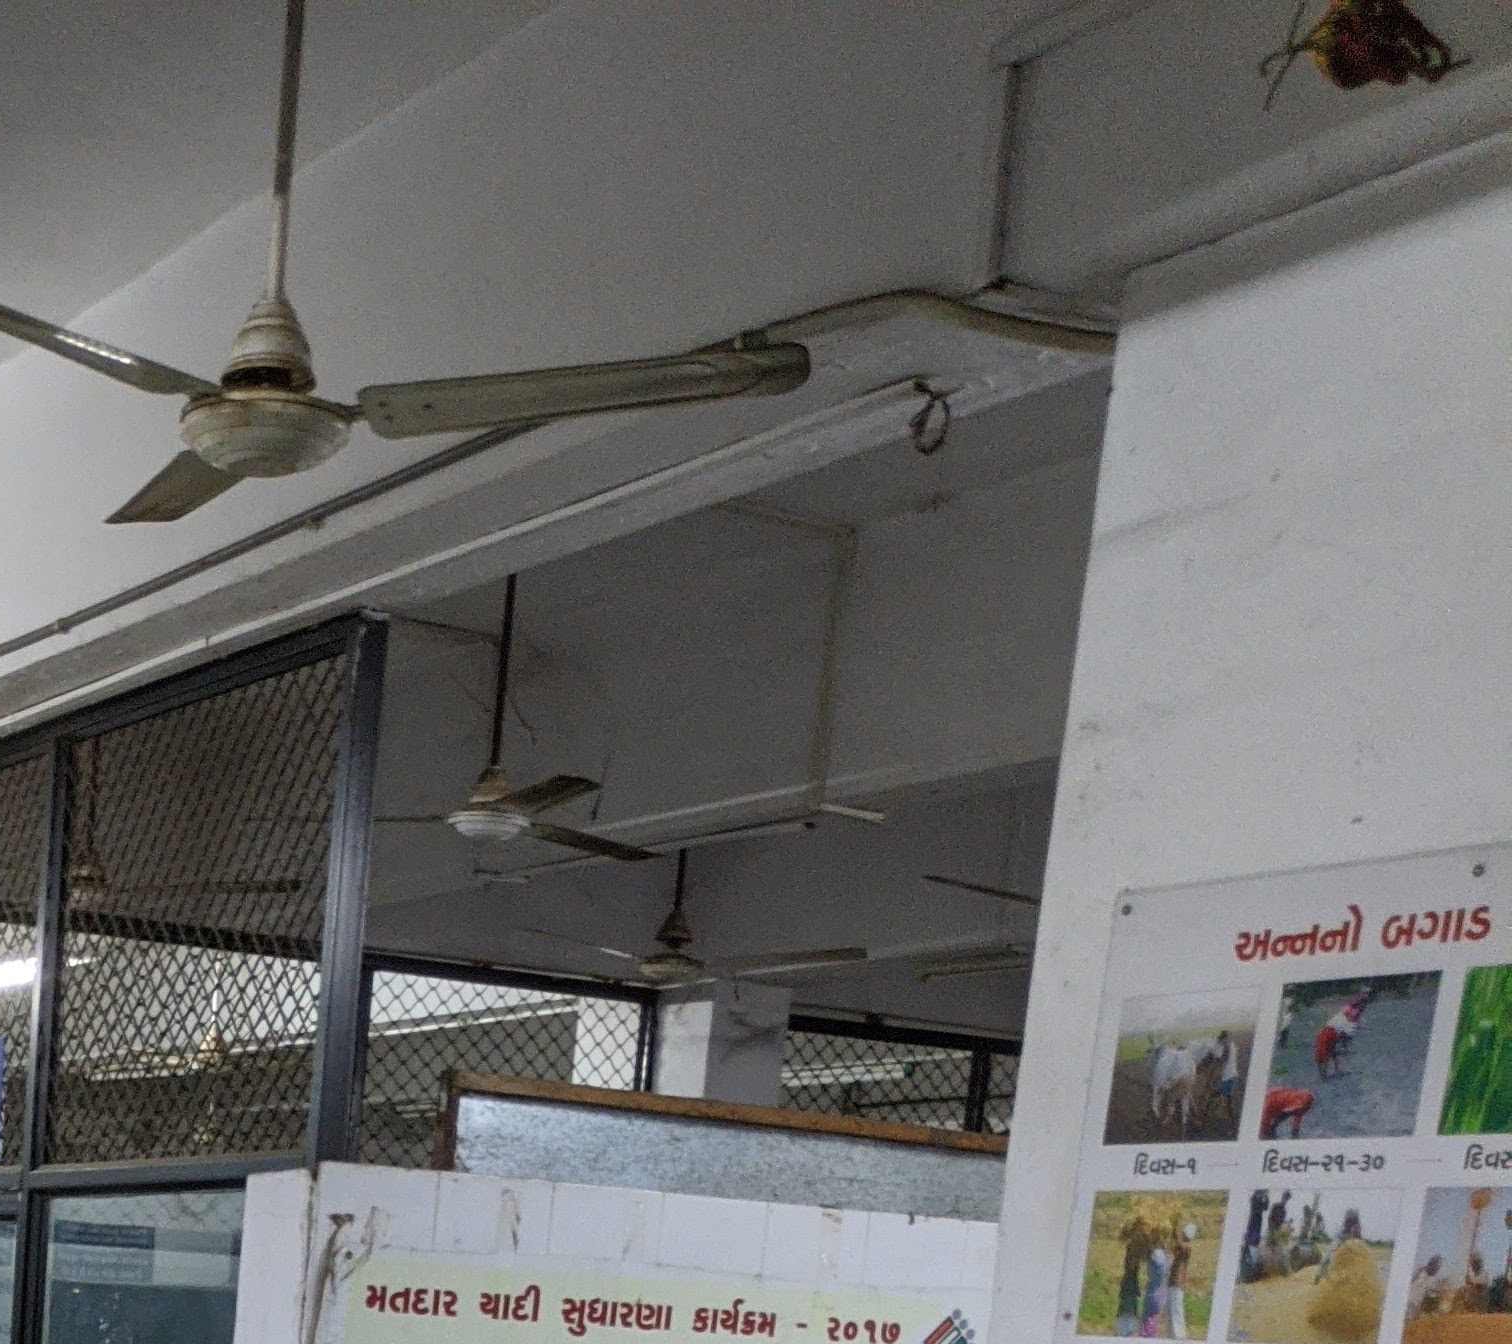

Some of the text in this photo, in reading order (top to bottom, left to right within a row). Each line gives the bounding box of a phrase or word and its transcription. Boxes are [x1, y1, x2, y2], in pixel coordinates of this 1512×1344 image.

[1234, 904, 1491, 961] અન્નનો બગાડ
[1134, 1152, 1196, 1175] દિવસ-૧
[364, 1284, 458, 1317] મતદાર
[692, 1299, 777, 1337] કાર્યક્રમ
[827, 1316, 901, 1344] ૨૦૧૭
